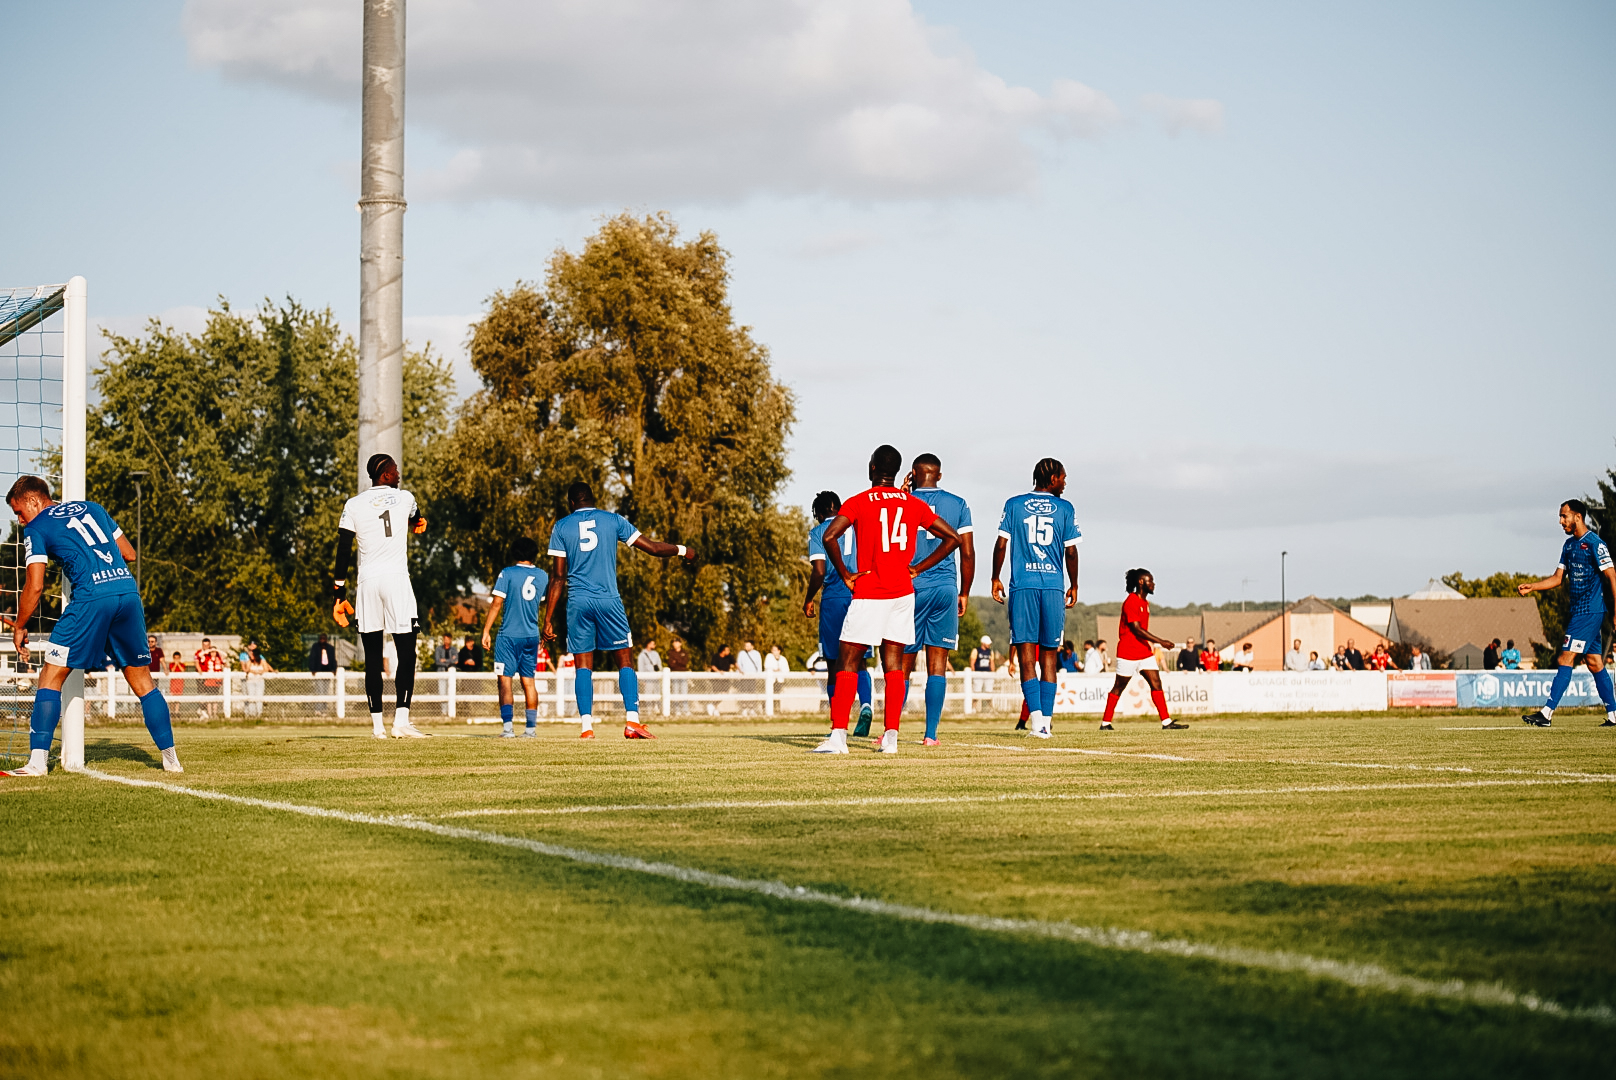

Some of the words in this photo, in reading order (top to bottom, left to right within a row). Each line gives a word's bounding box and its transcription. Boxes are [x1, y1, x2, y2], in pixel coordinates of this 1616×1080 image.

[868, 492, 881, 502] FC
[66, 513, 110, 547] 11
[379, 509, 393, 538] 1
[578, 519, 598, 551] 5
[879, 506, 908, 553] 14
[1023, 514, 1054, 546] 15
[91, 567, 130, 582] HELIOS
[522, 575, 537, 600] 6
[1079, 687, 1109, 701] dalk
[1165, 685, 1209, 702] dalkia
[1503, 680, 1587, 697] NATIOAL
